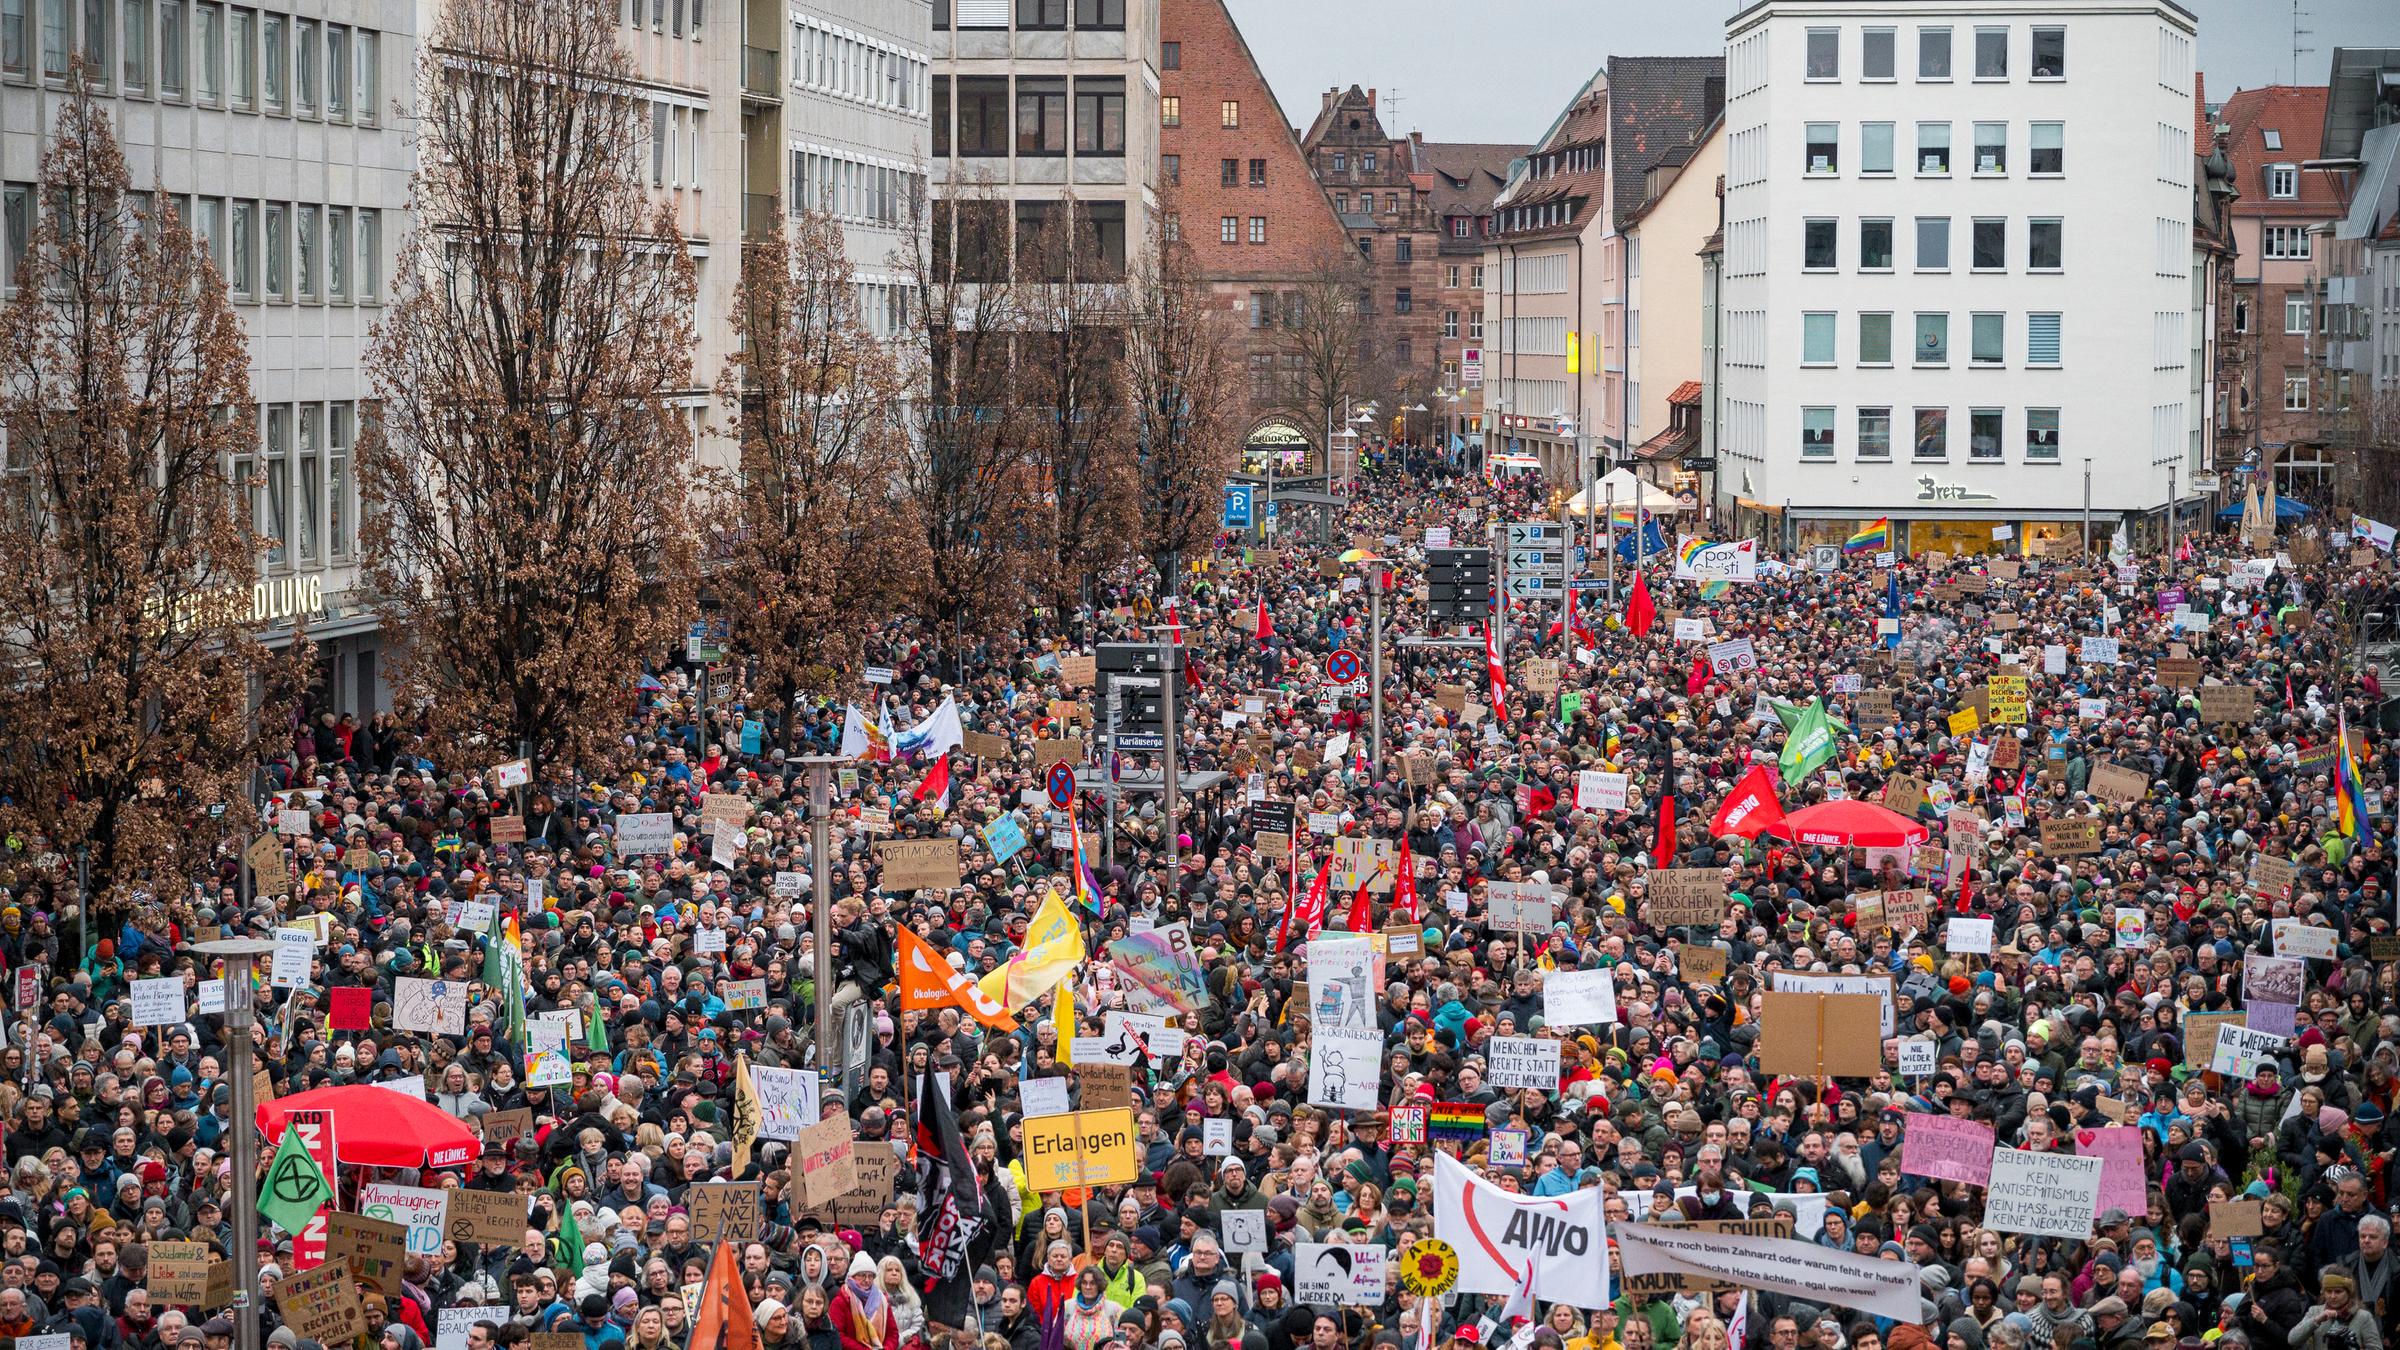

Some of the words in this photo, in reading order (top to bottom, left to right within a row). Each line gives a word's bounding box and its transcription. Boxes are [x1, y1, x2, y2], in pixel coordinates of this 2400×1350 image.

[1704, 551, 1737, 569] pax
[710, 672, 732, 686] STOP
[1991, 677, 2009, 685] WIR
[2073, 831, 2080, 839] IN
[1650, 871, 1678, 885] WIR
[1682, 871, 1703, 883] sind
[1706, 871, 1719, 881] die
[1652, 885, 1688, 897] STADT
[1691, 885, 1707, 894] der
[1887, 891, 1914, 905] AFD
[1493, 913, 1545, 932] Faschisten
[1654, 908, 1721, 925] RECHTE!
[1903, 913, 1925, 925] 1933
[281, 933, 308, 943] GEGEN
[913, 986, 950, 1001] Ökologisc
[1326, 1028, 1384, 1043] ORIENTIERUNG
[2219, 1026, 2236, 1045] NIE
[1494, 1041, 1537, 1056] MENSCHEN
[1910, 1045, 1923, 1053] NIE
[2241, 1050, 2253, 1058] IST
[1490, 1056, 1522, 1071] RECHTE
[1526, 1061, 1557, 1075] STATT
[1901, 1054, 1931, 1062] WIEDER
[1901, 1064, 1910, 1072] IST
[1911, 1063, 1932, 1072] JETZT
[1489, 1072, 1519, 1086] RECHTE
[1522, 1074, 1557, 1089] MENSCHEN
[1086, 1083, 1108, 1096] gegen
[1109, 1082, 1123, 1092] den
[292, 1111, 323, 1125] AfD
[1393, 1108, 1422, 1123] WIR
[489, 1124, 513, 1141] NEIN
[1393, 1120, 1424, 1131] bleiben
[1393, 1128, 1422, 1141] BUNT
[1033, 1131, 1126, 1155] Erlangen
[434, 1150, 444, 1165] DIE
[868, 1155, 885, 1167] nur
[1493, 1151, 1523, 1162] BRAUN
[2016, 1153, 2036, 1165] EIN
[2038, 1155, 2094, 1173] MENSCH!
[2025, 1171, 2059, 1186] KEIN
[694, 1187, 710, 1205] A
[721, 1189, 756, 1205] NAZI
[1991, 1183, 2090, 1203] ANTISEMITISMUS
[454, 1202, 487, 1216] STEHEN
[696, 1207, 708, 1223] F
[720, 1206, 755, 1222] NAZI
[1988, 1199, 2013, 1213] KEIN
[2017, 1201, 2048, 1216] HASS
[2058, 1205, 2092, 1220] HETZE
[412, 1212, 441, 1227] sind
[486, 1216, 524, 1229] RECHTS!
[1992, 1212, 2026, 1227] KEINE
[2029, 1215, 2087, 1232] NEONAZIS
[694, 1223, 711, 1240] D
[1501, 1207, 1589, 1257] AWO
[406, 1226, 441, 1254] AfD
[1651, 1237, 1675, 1250] Merz
[1676, 1240, 1701, 1252] noch
[1702, 1242, 1729, 1254] beim
[1731, 1244, 1777, 1263] Zahnarzt
[1779, 1253, 1802, 1266] oder
[1804, 1259, 1838, 1274] warum
[1839, 1262, 1861, 1277] fehlt
[1863, 1271, 1873, 1280] er
[1875, 1270, 1904, 1286] heute
[153, 1264, 176, 1281] Liebe
[1732, 1261, 1761, 1276] Hetze
[1762, 1271, 1797, 1287] ächten
[1804, 1279, 1827, 1294] egal
[1828, 1284, 1847, 1294] von
[1299, 1281, 1311, 1290] SIE
[1311, 1281, 1329, 1290] SIND
[1402, 1272, 1427, 1297] NEIN
[1431, 1267, 1459, 1297] DANKE!
[174, 1283, 201, 1302] Waffen
[1299, 1291, 1331, 1303] WIEDER
[1333, 1292, 1346, 1303] DA
[438, 1307, 505, 1321] DEMOKRATIE
[302, 1313, 343, 1334] RECHTE
